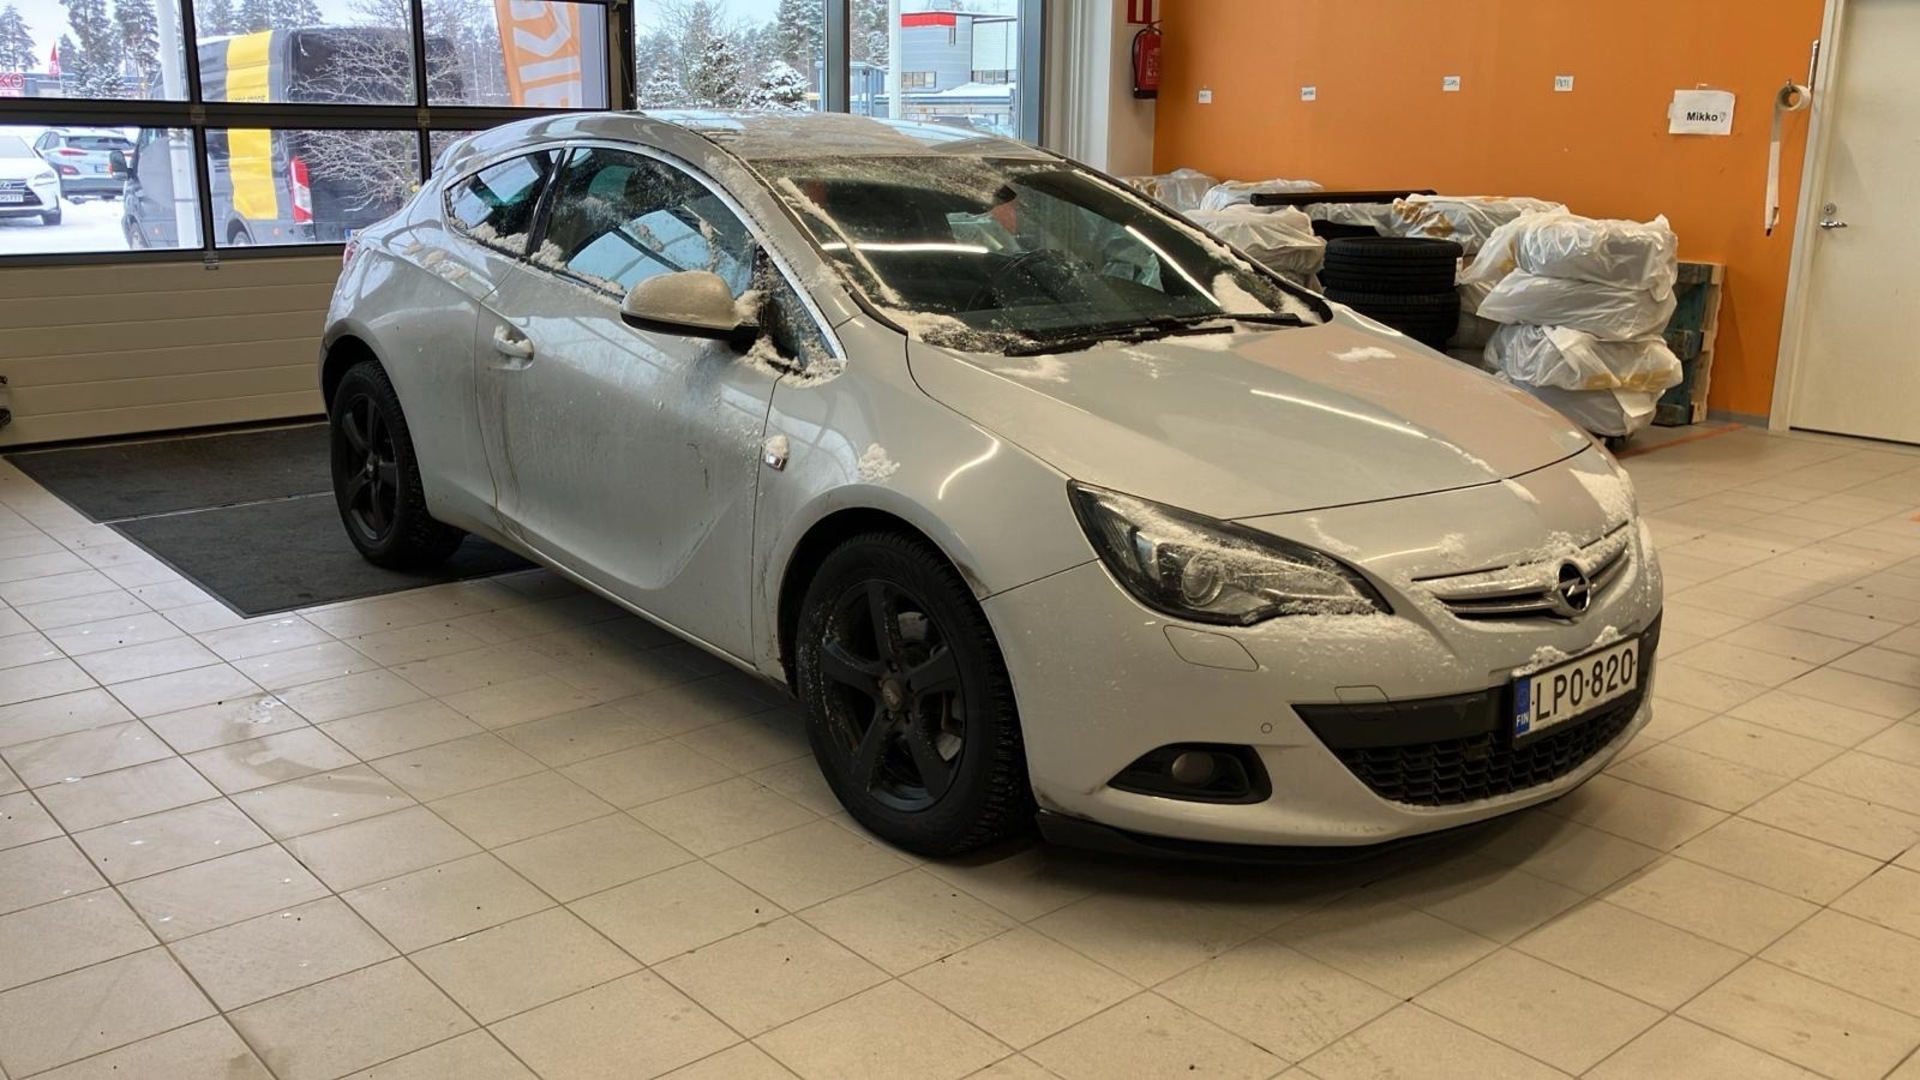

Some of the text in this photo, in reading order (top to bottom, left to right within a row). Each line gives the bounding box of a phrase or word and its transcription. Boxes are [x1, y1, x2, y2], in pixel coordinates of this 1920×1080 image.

[1686, 111, 1718, 122] Mikko
[1535, 648, 1634, 722] LPO-820
[1516, 713, 1529, 727] FIN
